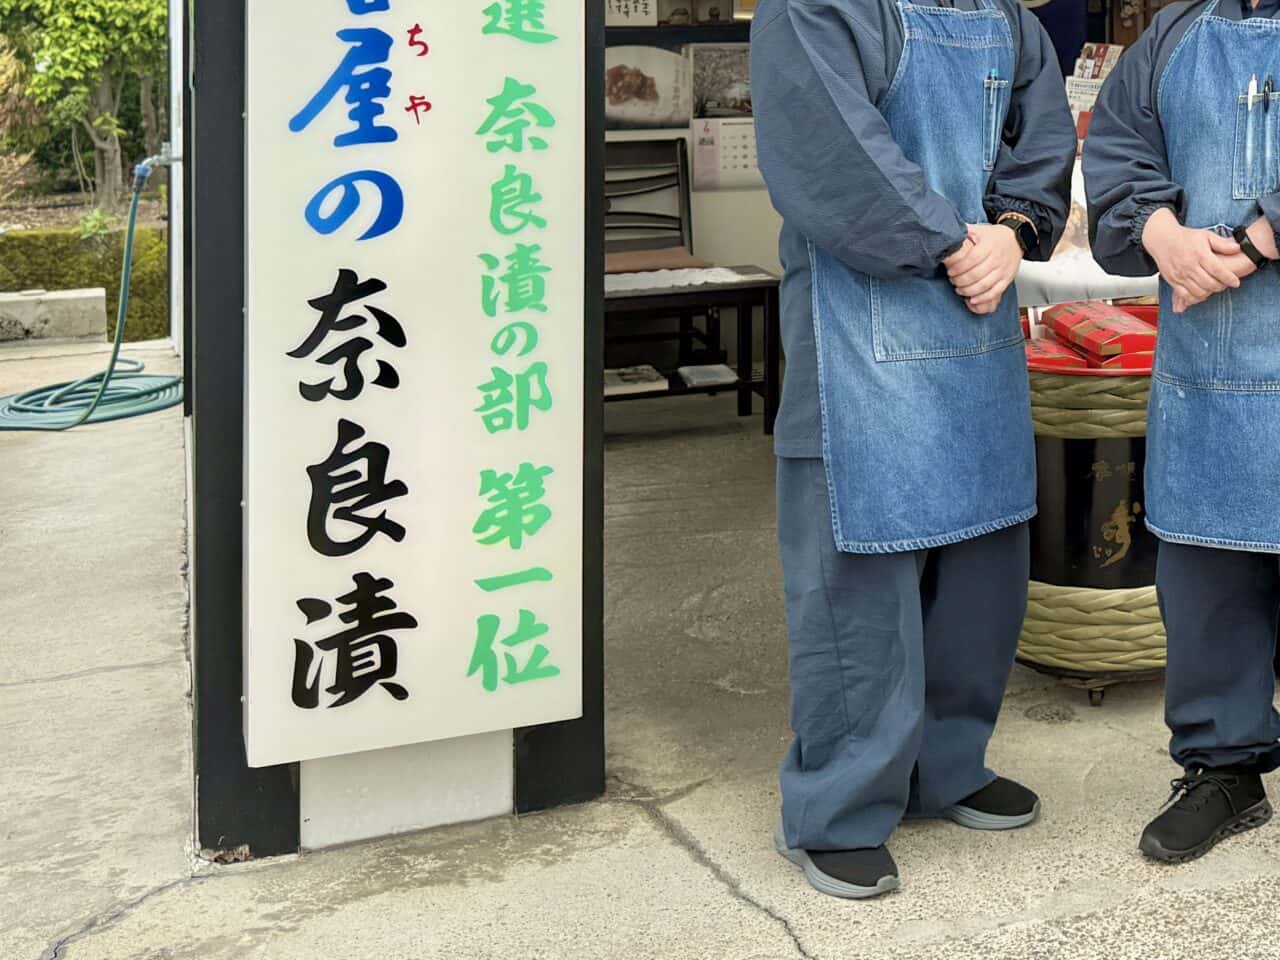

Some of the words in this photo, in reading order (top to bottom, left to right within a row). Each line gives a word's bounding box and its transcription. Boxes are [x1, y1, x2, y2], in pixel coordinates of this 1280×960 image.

[475, 76, 556, 434] 奈良漬の部
[466, 462, 561, 693] 第一位
